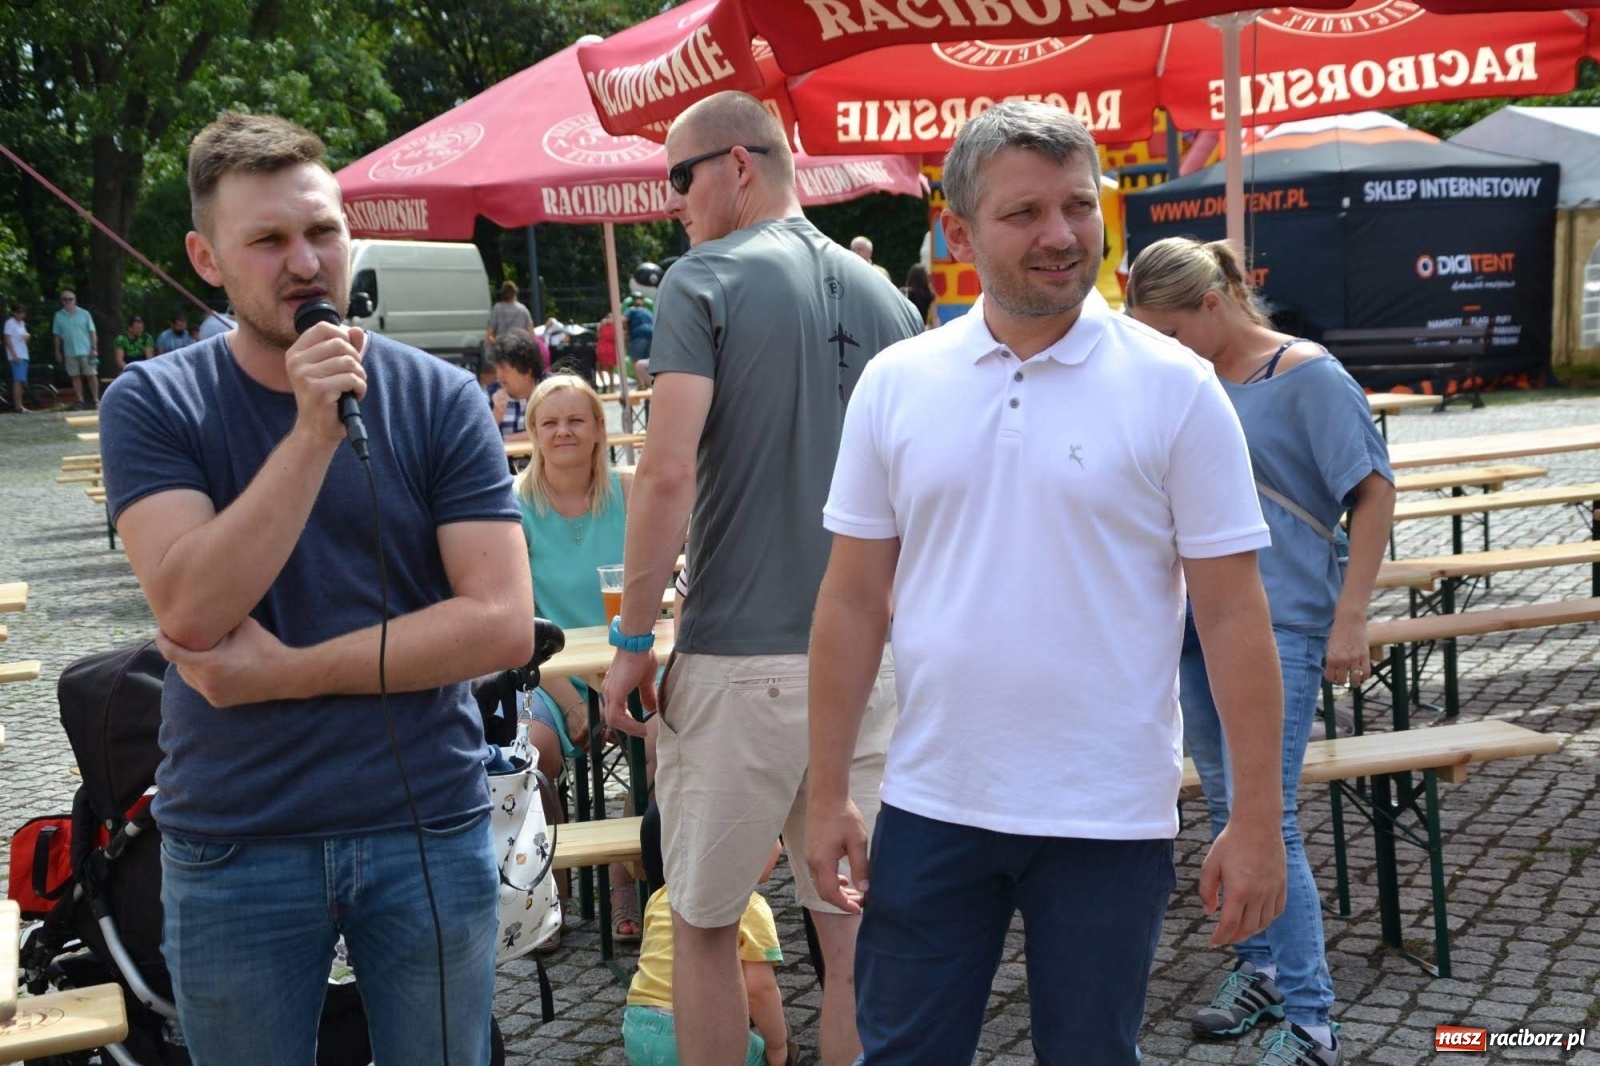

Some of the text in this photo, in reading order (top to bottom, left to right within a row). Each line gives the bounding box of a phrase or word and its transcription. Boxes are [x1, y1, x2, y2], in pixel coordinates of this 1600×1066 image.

[802, 0, 1188, 41] RACIBOR
[541, 179, 669, 216] RACIBORSKI
[1150, 188, 1309, 223] WWW.DITENT.PL
[1363, 177, 1542, 202] SKLEP INTERNETOWY
[343, 199, 429, 231] ACIBORSKIE
[1436, 251, 1516, 276] DIGITENT
